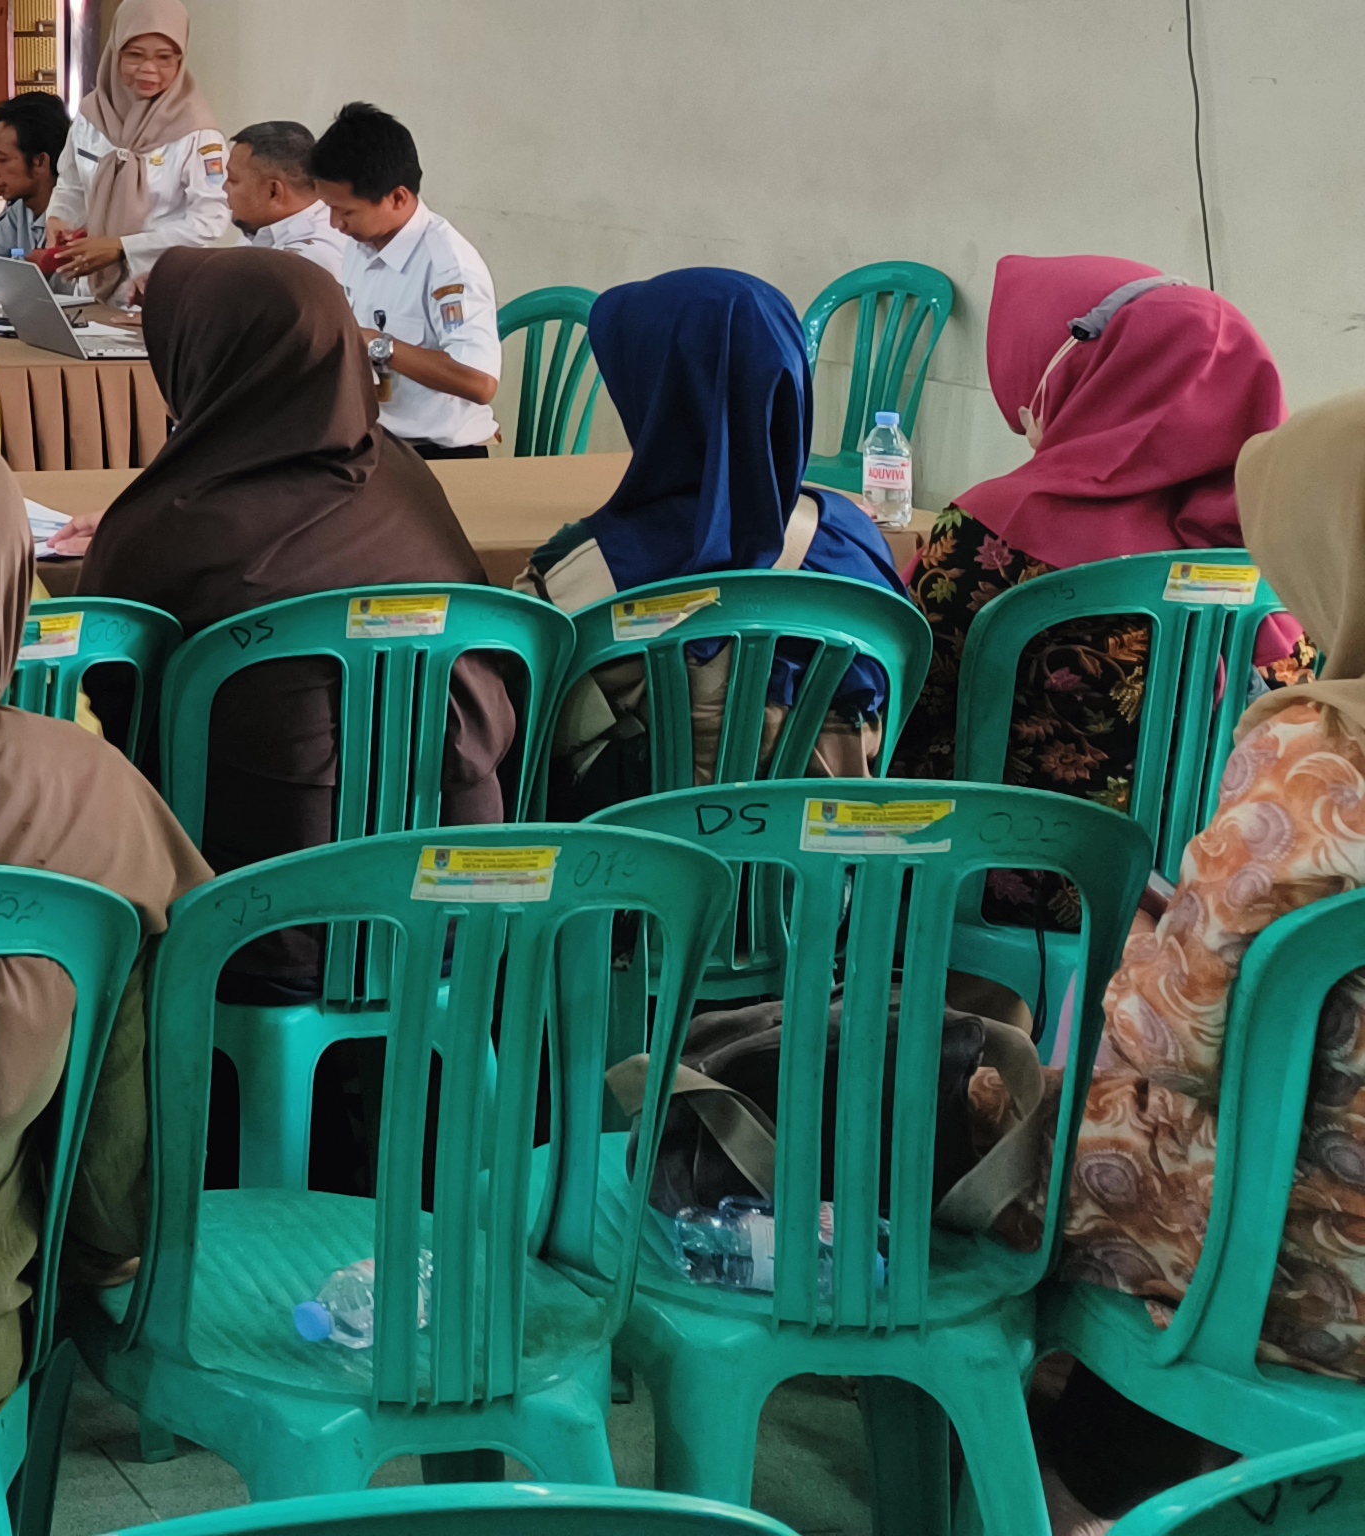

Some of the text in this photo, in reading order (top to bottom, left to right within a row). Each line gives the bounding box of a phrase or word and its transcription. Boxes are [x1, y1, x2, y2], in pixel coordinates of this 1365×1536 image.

[868, 467, 905, 481] AQUVIVA
[228, 615, 274, 650] DS
[694, 802, 770, 837] DS
